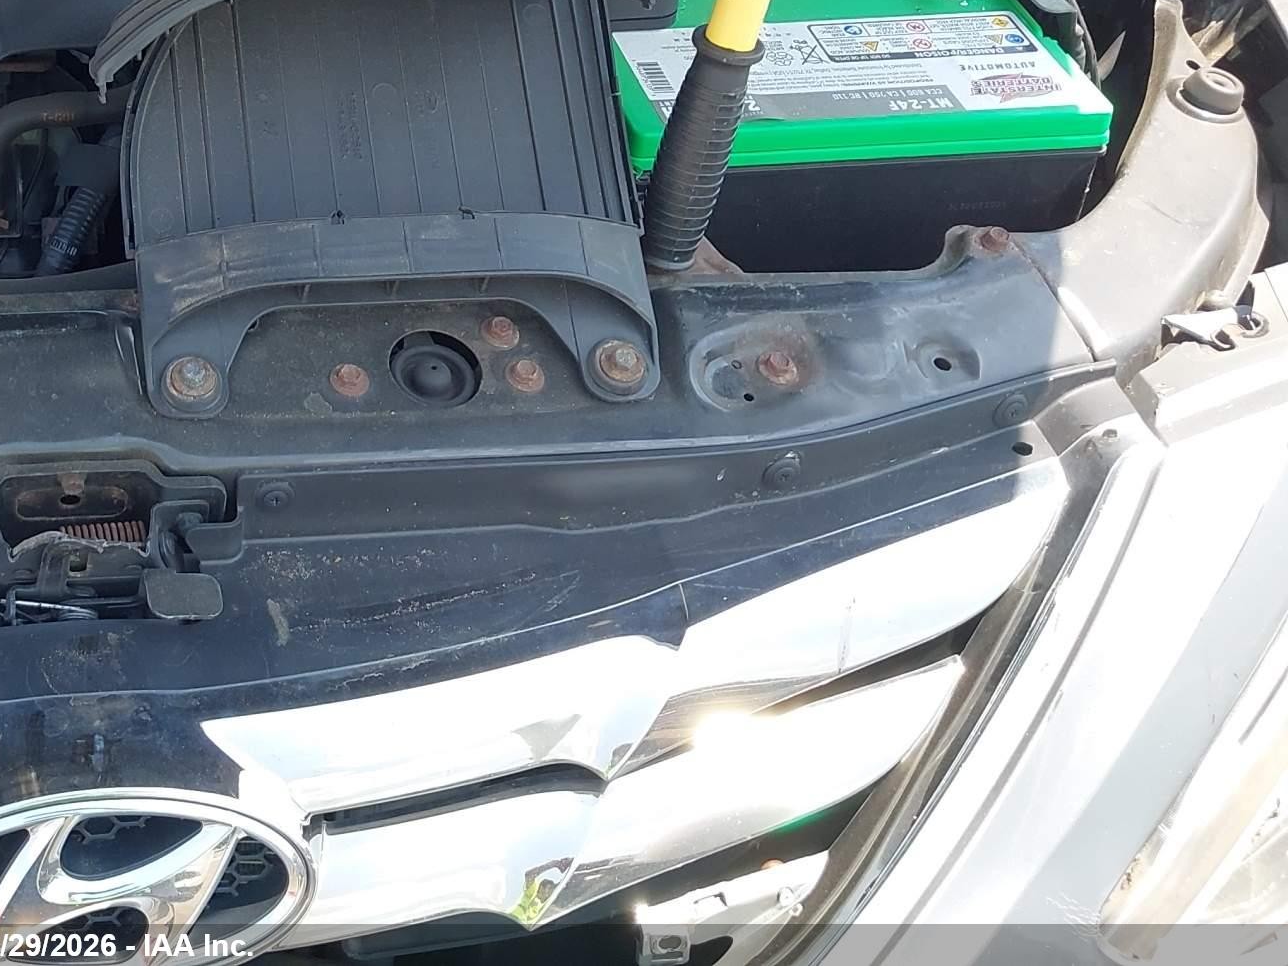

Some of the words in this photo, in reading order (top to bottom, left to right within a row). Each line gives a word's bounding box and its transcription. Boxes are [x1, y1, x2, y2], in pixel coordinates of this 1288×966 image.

[914, 47, 1004, 57] DANGER/POISON
[958, 61, 1036, 71] AUTOMOTIVE
[970, 76, 1053, 88] BATTERIES
[885, 90, 900, 98] CA
[924, 88, 943, 96] CCA
[970, 83, 1061, 96] INTERSTATE
[888, 97, 954, 111] MT-24F
